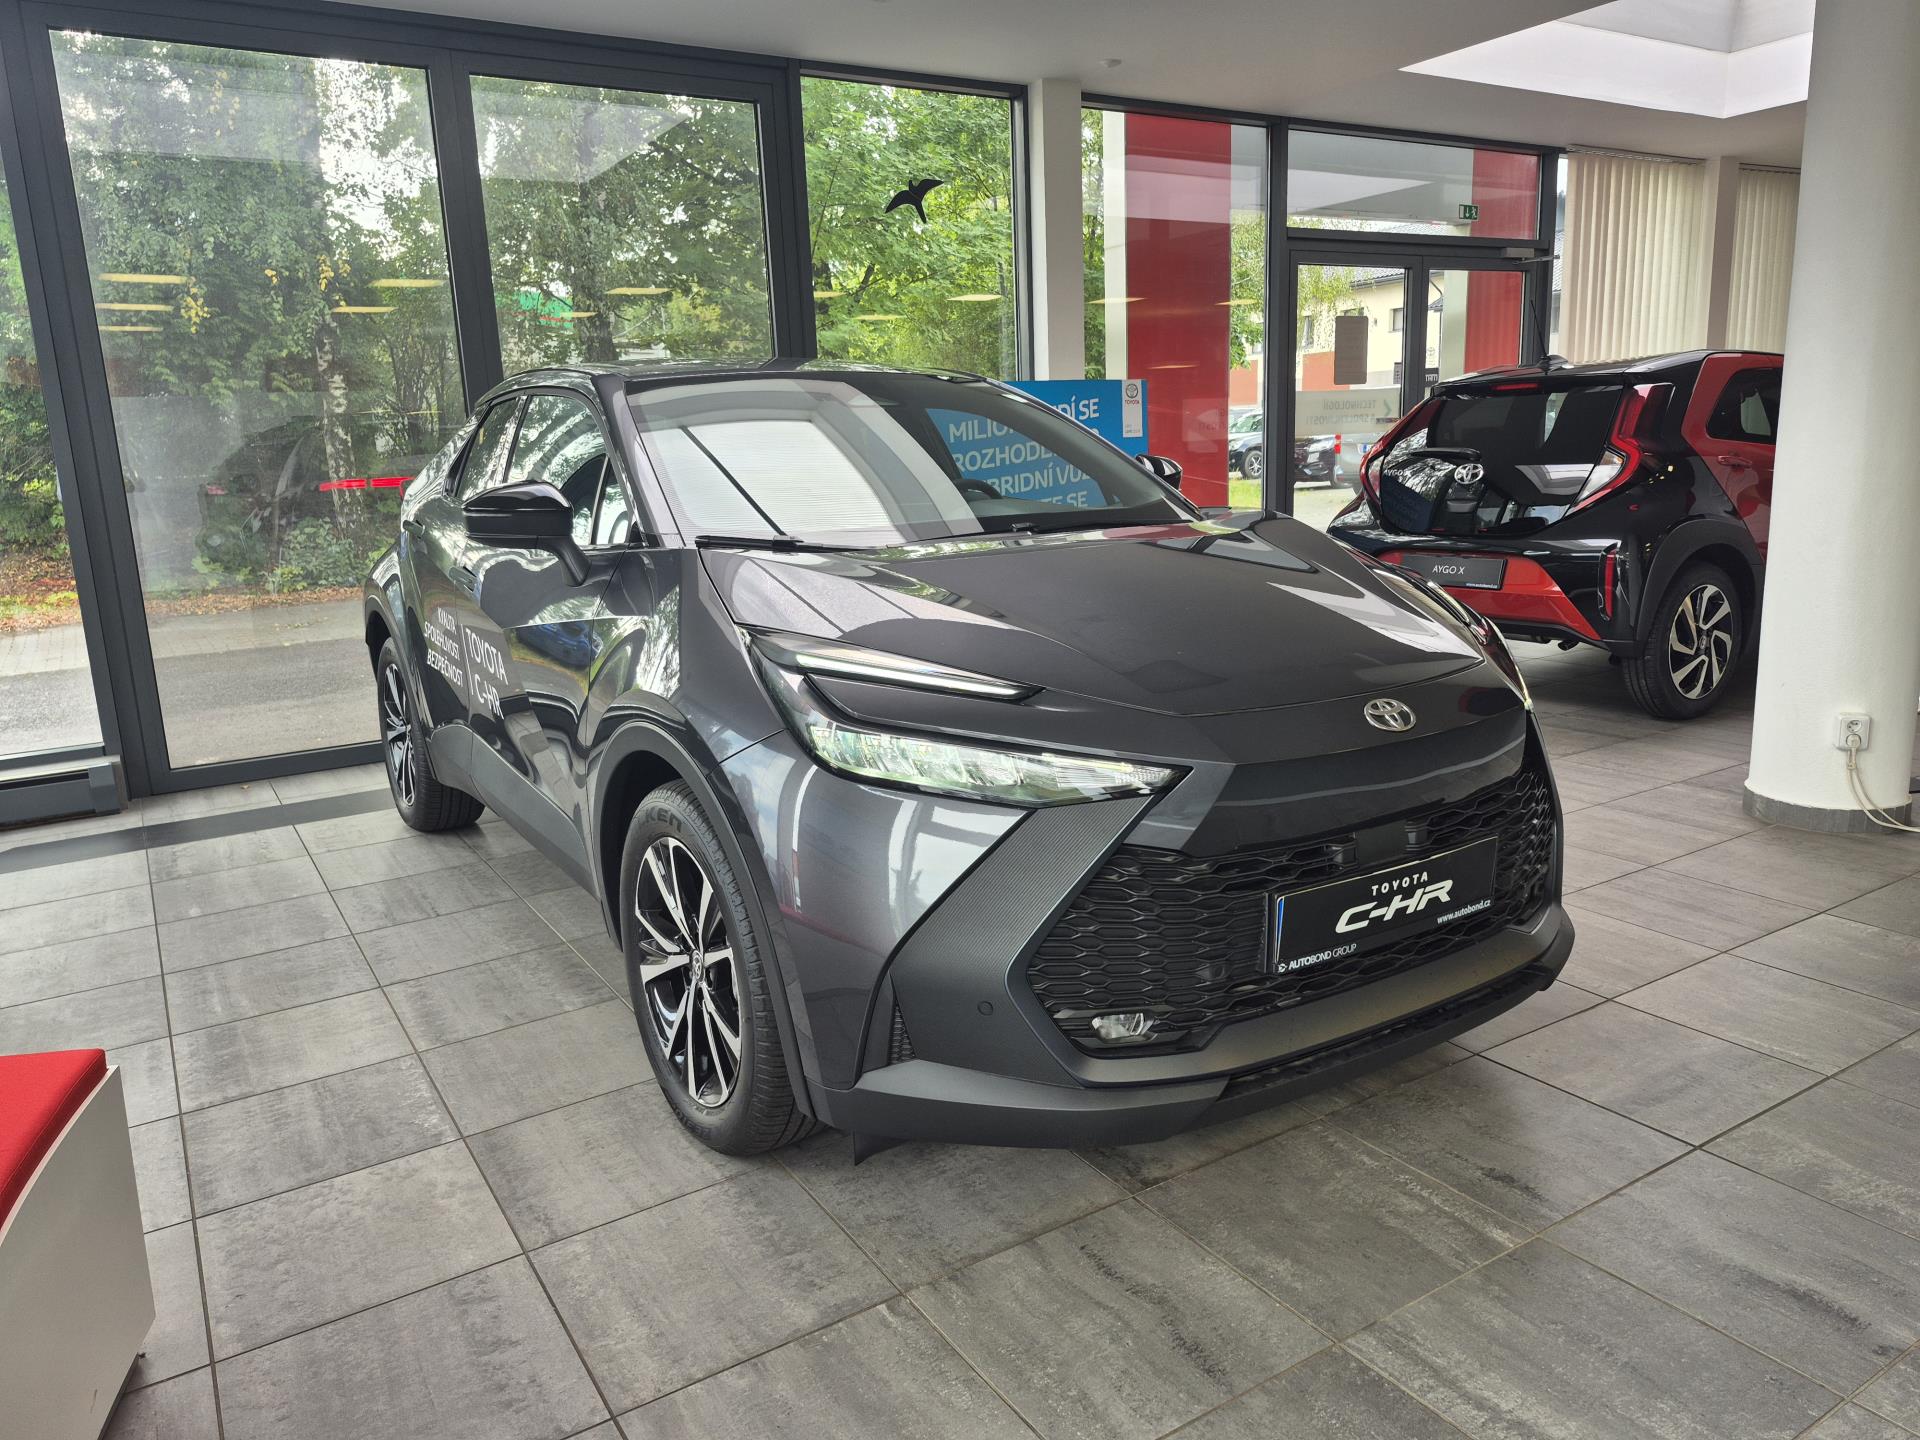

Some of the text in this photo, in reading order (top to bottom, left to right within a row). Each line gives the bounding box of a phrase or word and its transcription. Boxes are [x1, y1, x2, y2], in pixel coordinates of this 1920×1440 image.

[948, 418, 1013, 443] MILIO
[1079, 398, 1100, 420] SE
[952, 441, 1057, 472] ROZHODL
[984, 462, 1053, 496] BRIDNÍ
[1432, 564, 1465, 575] AYGO X
[427, 648, 463, 687] BEZPEČNOST
[466, 628, 508, 686] TOYOTA
[475, 674, 504, 720] C-HR
[1372, 871, 1428, 896] TOYOTA
[1335, 879, 1453, 933] C-HR
[1437, 899, 1491, 925] www.autobond.cz
[1288, 943, 1357, 970] AUTOBOND GROUP
